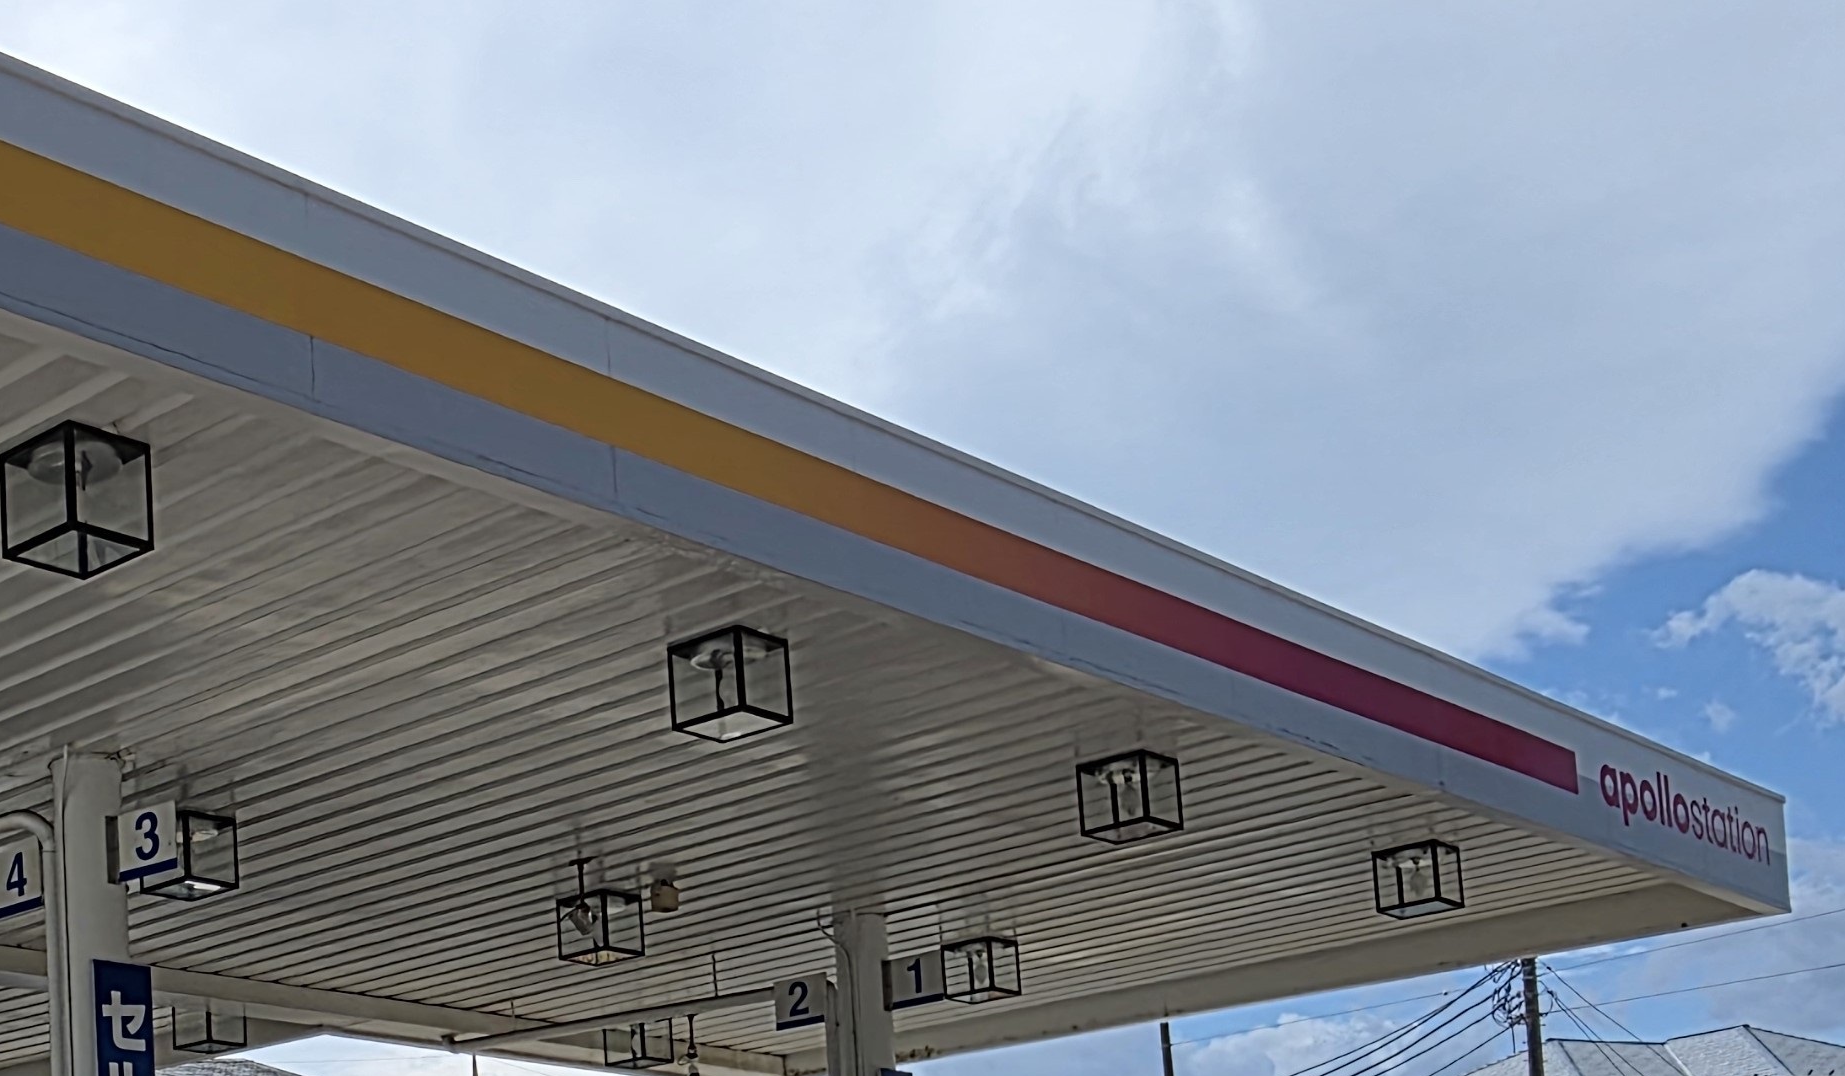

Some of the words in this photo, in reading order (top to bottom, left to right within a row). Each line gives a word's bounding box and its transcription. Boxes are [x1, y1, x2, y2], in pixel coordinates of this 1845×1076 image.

[134, 811, 160, 861] 3
[1600, 763, 1771, 867] apollostation
[6, 851, 28, 897] 4
[907, 957, 923, 994] 1
[788, 981, 810, 1017] 2
